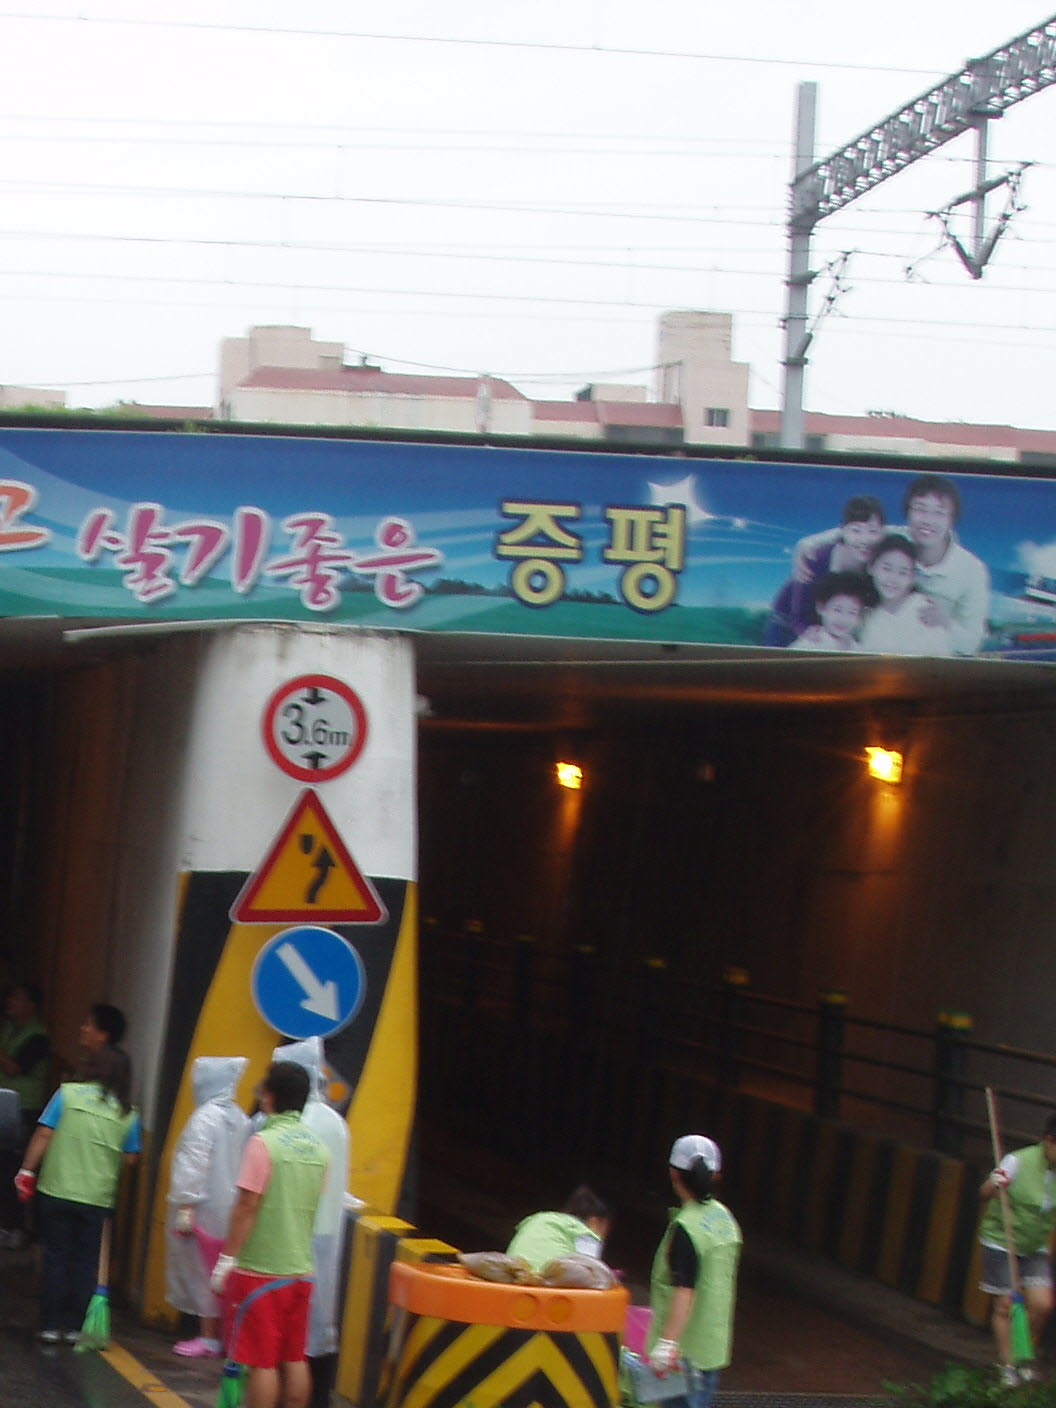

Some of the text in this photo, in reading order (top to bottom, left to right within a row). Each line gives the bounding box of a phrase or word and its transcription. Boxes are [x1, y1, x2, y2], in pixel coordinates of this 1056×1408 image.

[79, 503, 440, 610] 살기좋은
[496, 499, 688, 612] 증평
[280, 702, 350, 746] 3.6m
